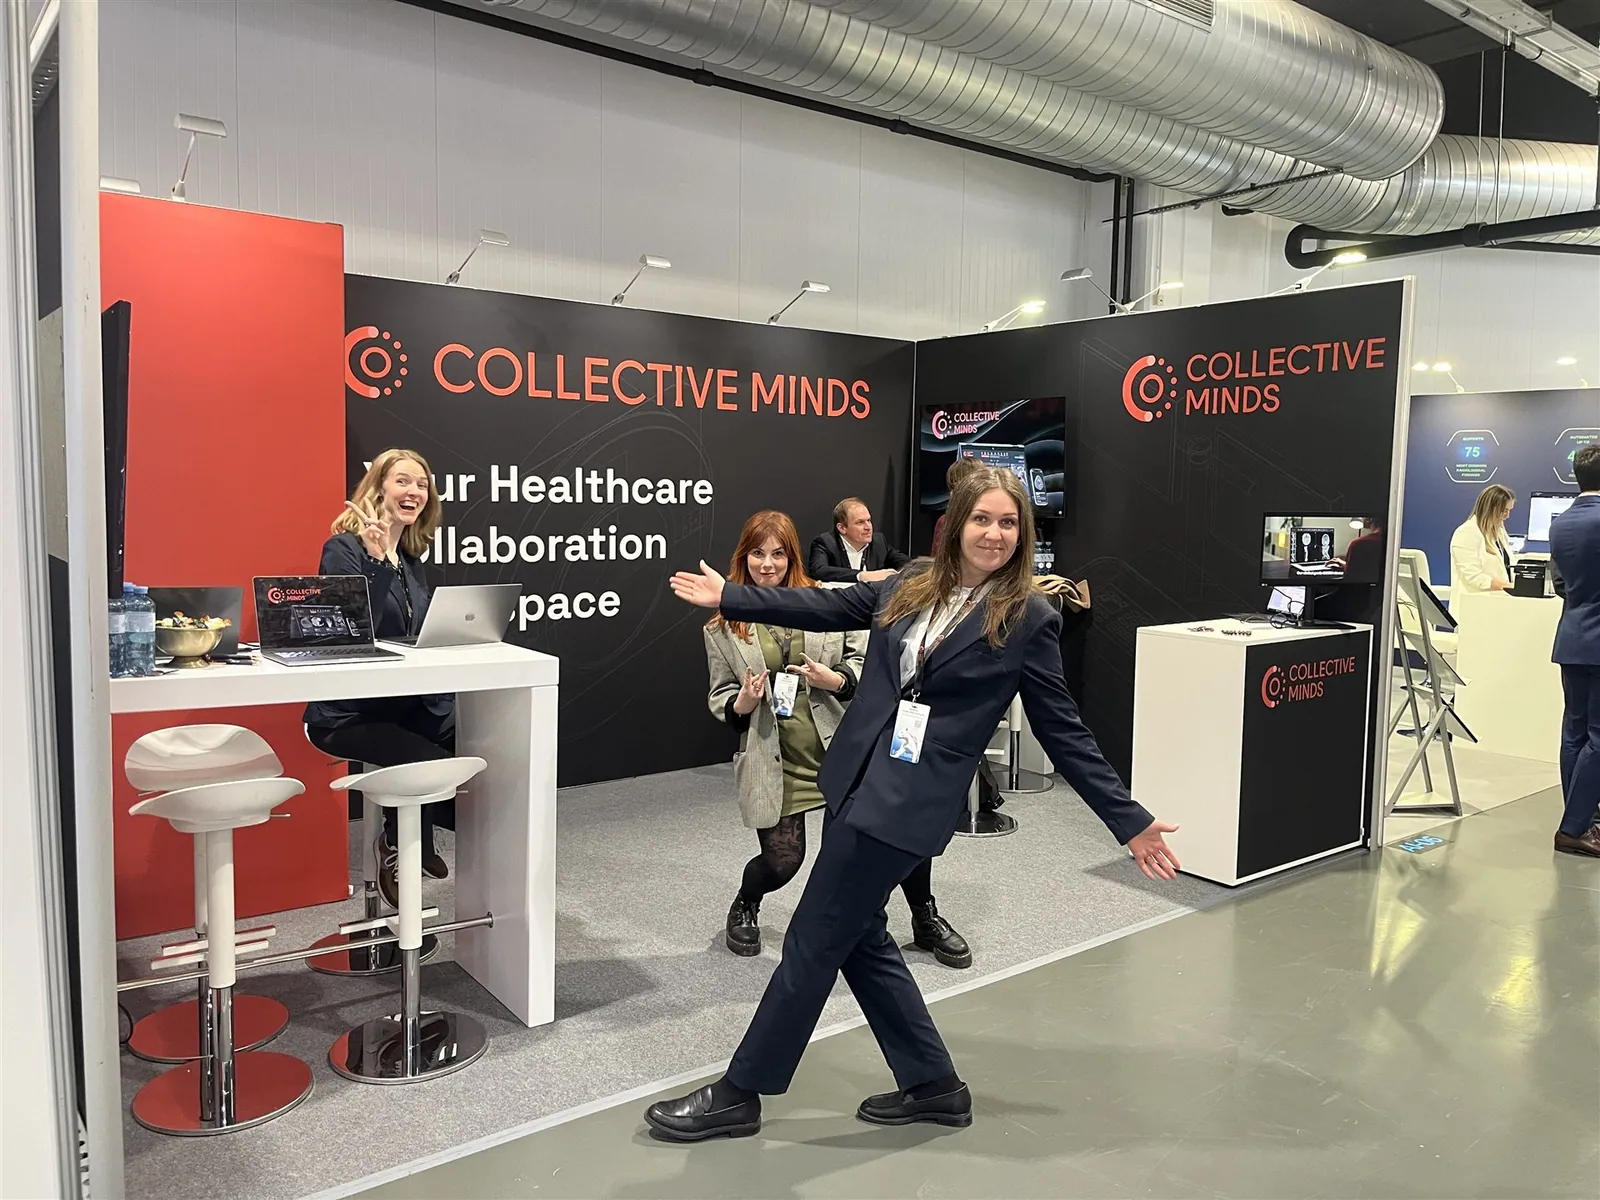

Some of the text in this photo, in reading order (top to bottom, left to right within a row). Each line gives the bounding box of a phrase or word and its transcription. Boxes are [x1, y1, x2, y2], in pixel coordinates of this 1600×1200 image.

[1186, 337, 1386, 382] COLLECTIVE
[433, 343, 871, 419] COLLECTIVE MINDS
[1185, 383, 1280, 415] MINDS
[953, 411, 1000, 422] COLLECTIVE
[953, 425, 978, 434] MINDS
[1465, 446, 1480, 458] 75
[490, 464, 714, 505] Healthcare
[420, 524, 668, 565] llaboration
[509, 590, 621, 632] pace
[1289, 656, 1355, 682] COLLECTIVE
[1288, 680, 1324, 702] MINDS
